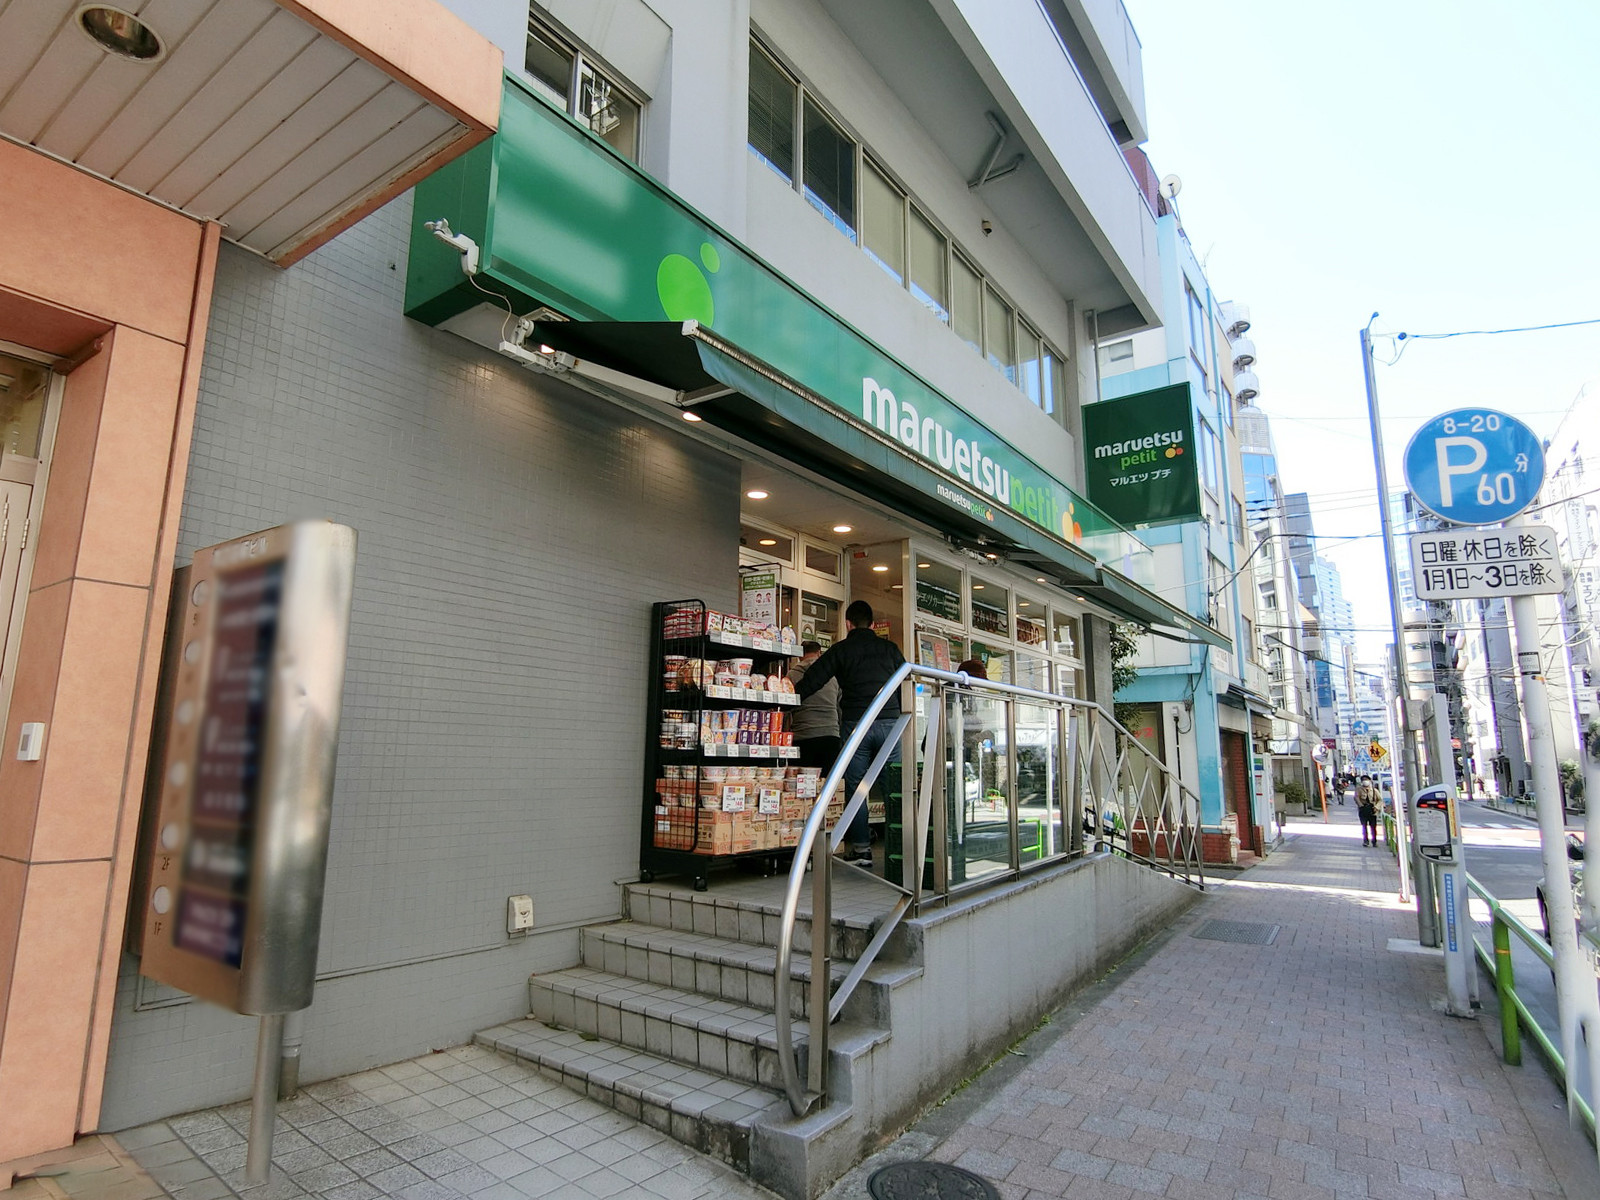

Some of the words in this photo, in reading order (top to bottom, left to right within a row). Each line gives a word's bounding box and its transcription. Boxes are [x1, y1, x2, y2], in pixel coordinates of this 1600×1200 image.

[1443, 414, 1500, 434] 8-20
[1094, 430, 1183, 459] maruetsu
[1120, 449, 1157, 470] petit
[1514, 453, 1529, 473] 分
[1109, 472, 1149, 487] マルエツ
[1151, 468, 1172, 480] プチ
[1435, 436, 1488, 507] P
[1476, 472, 1516, 505] 60
[162, 857, 170, 870] 2F
[154, 921, 162, 935] 1F
